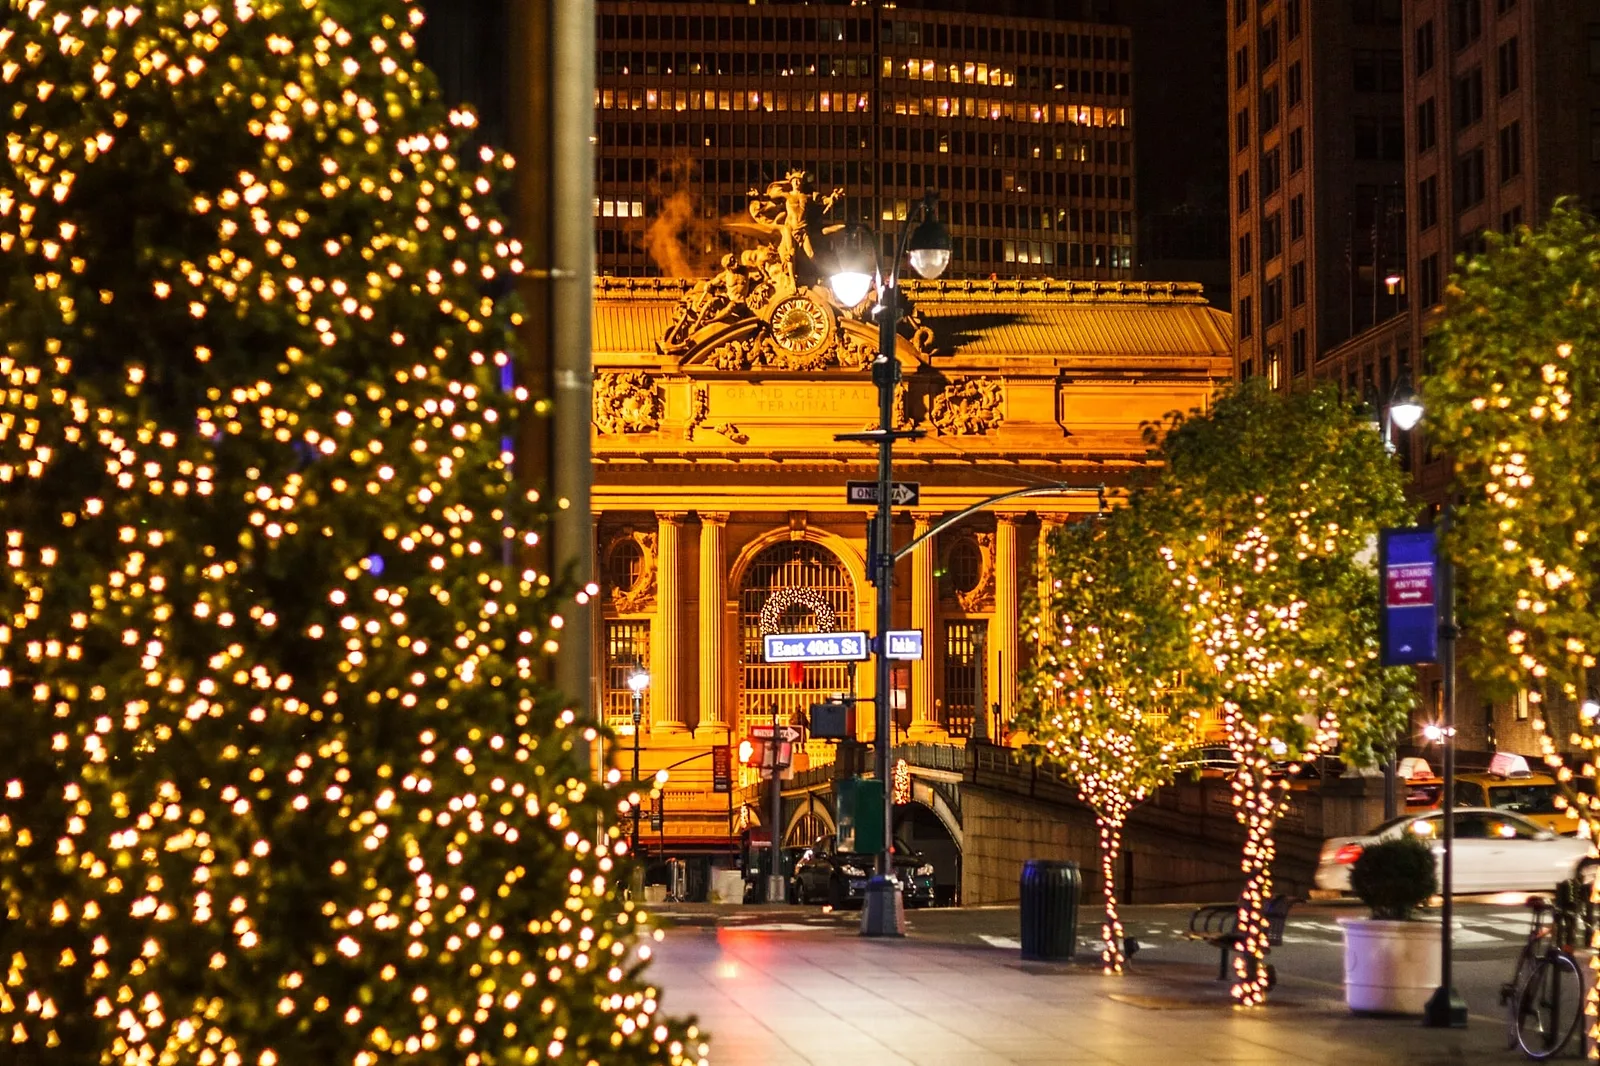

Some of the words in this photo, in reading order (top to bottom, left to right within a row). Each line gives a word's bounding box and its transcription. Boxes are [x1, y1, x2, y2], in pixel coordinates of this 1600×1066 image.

[726, 388, 783, 399] GRAND
[795, 388, 871, 400] CENTRAL
[757, 400, 839, 412] TERMINAL
[857, 488, 877, 498] ONE
[1400, 568, 1432, 578] STANDING
[1394, 579, 1428, 589] ANYTIME
[771, 641, 805, 657] East
[807, 639, 840, 656] 40th
[841, 638, 859, 655] St
